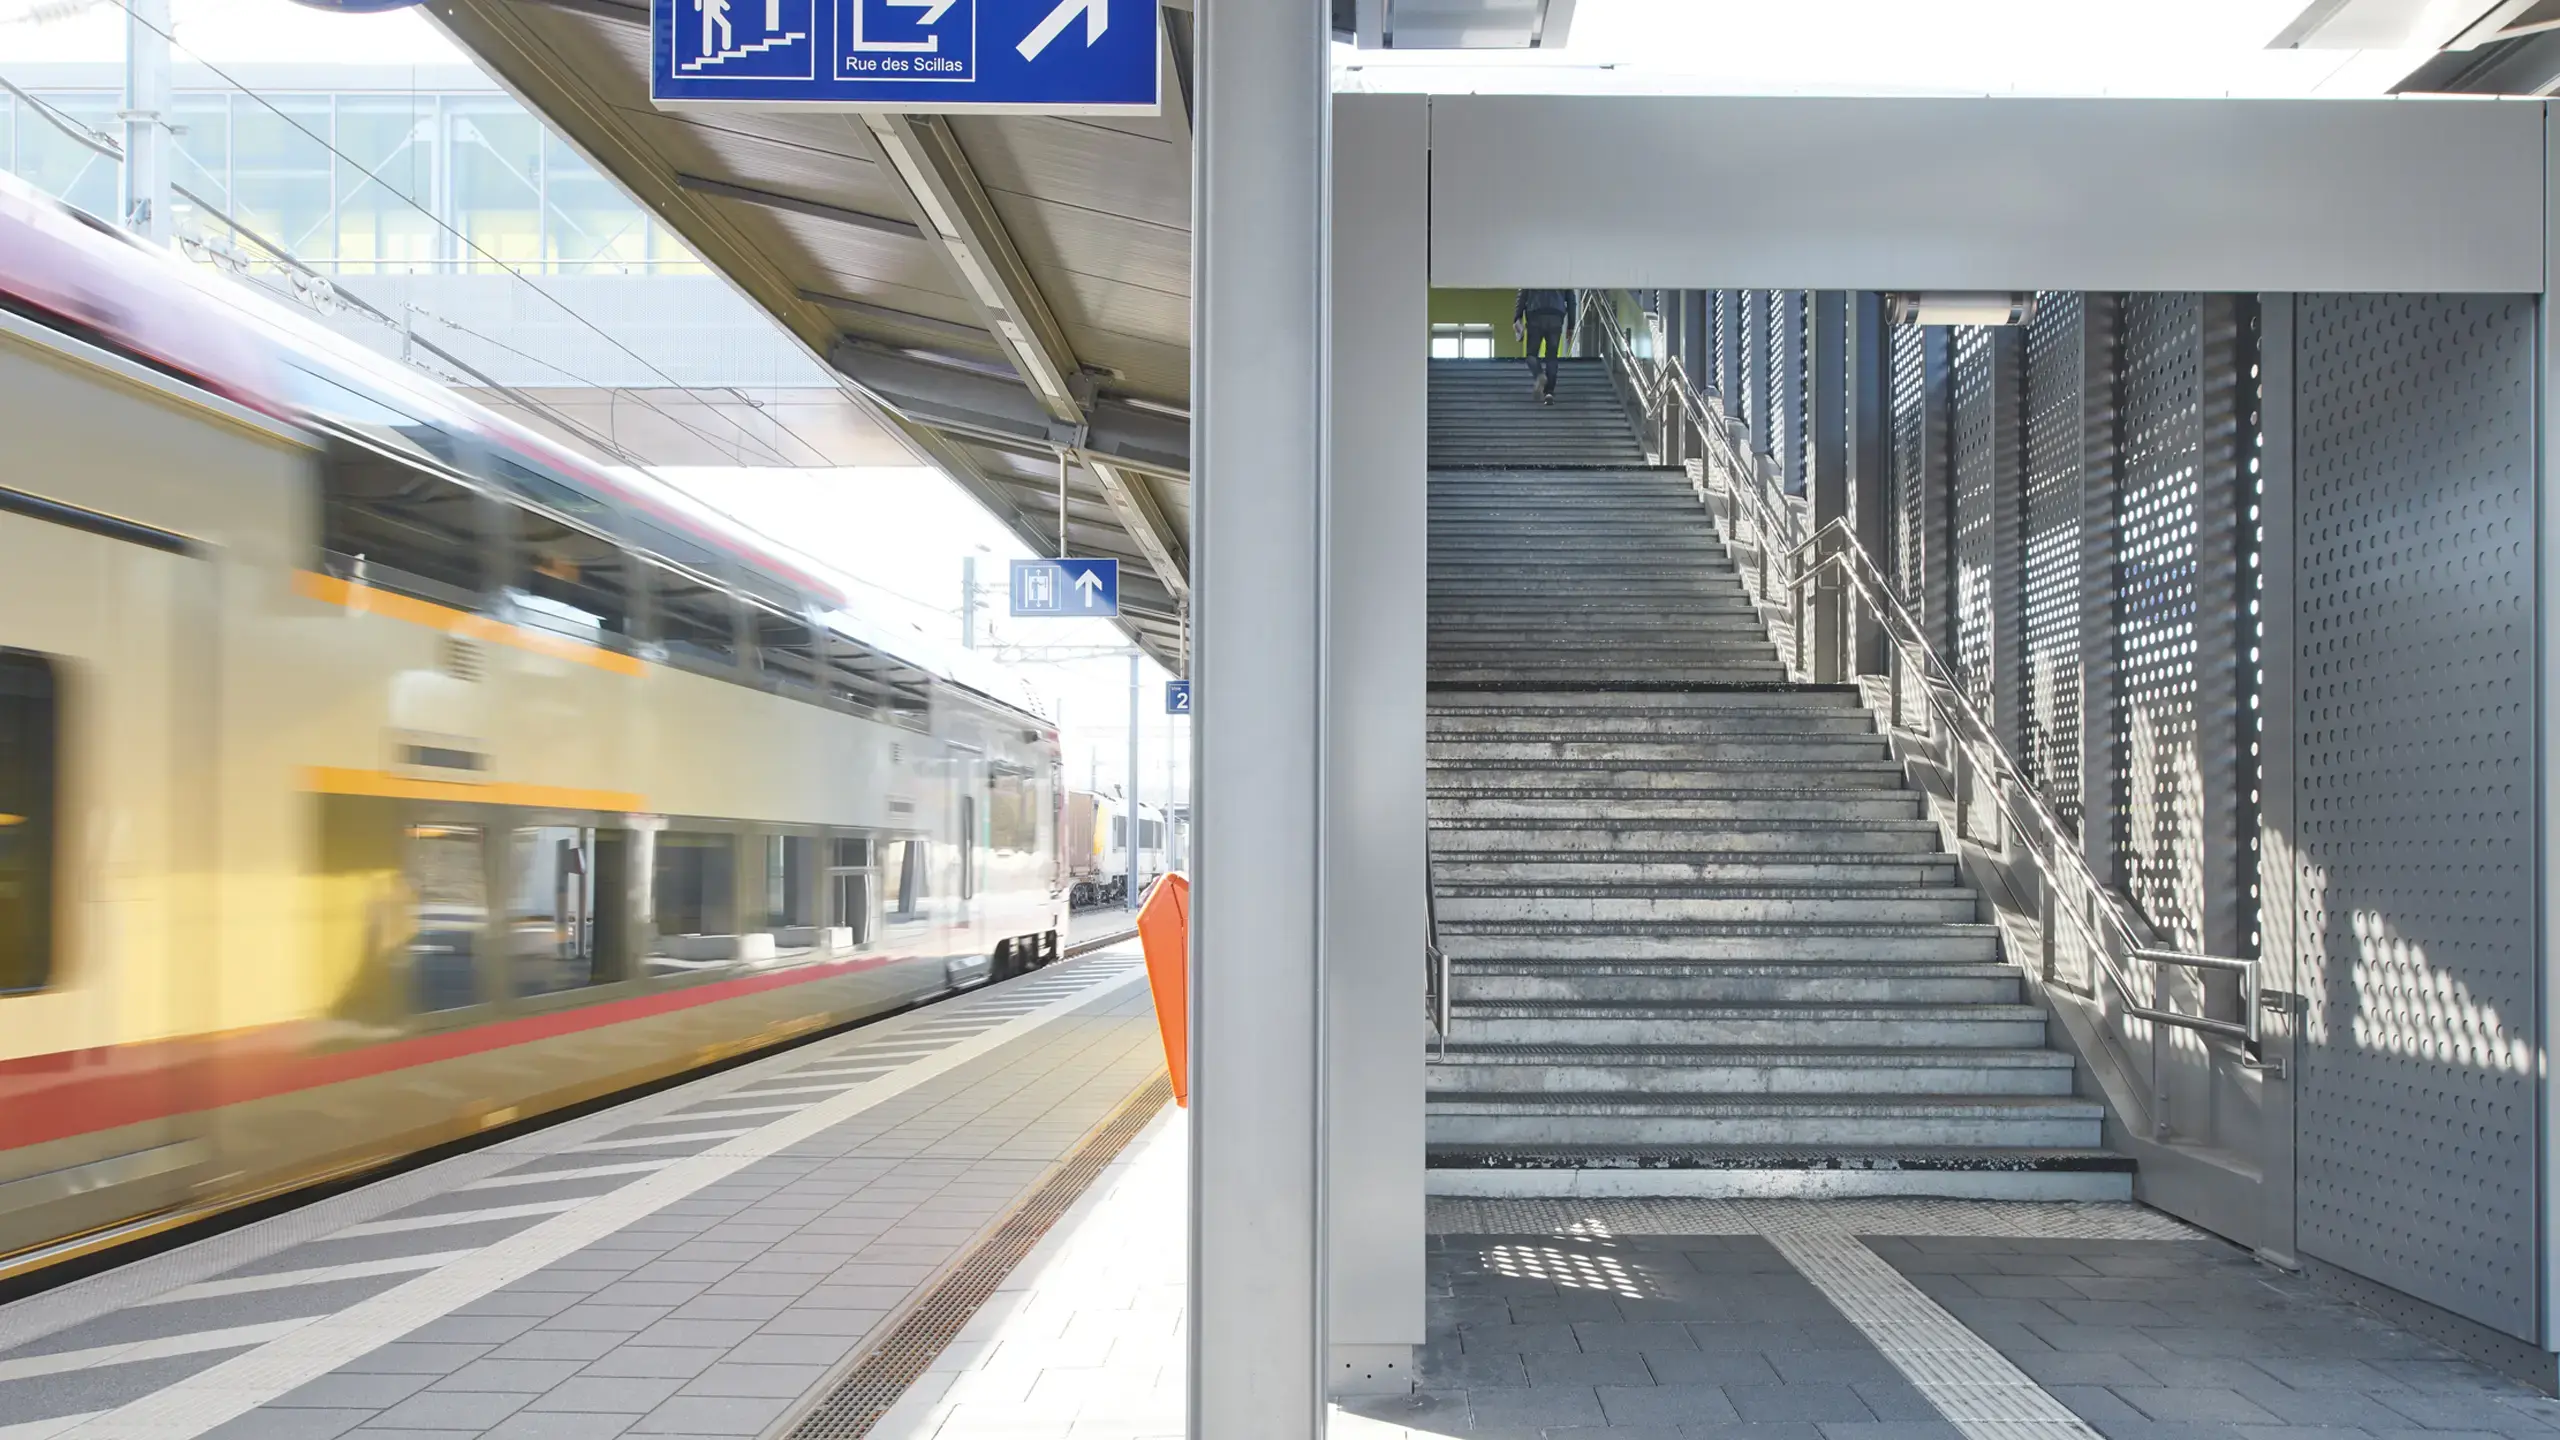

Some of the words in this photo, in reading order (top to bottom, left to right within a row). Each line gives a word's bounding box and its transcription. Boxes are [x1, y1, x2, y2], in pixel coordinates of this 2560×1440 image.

[846, 56, 877, 71] Rue
[881, 56, 909, 71] des
[913, 57, 963, 72] Scillas
[1177, 692, 1188, 709] 2
